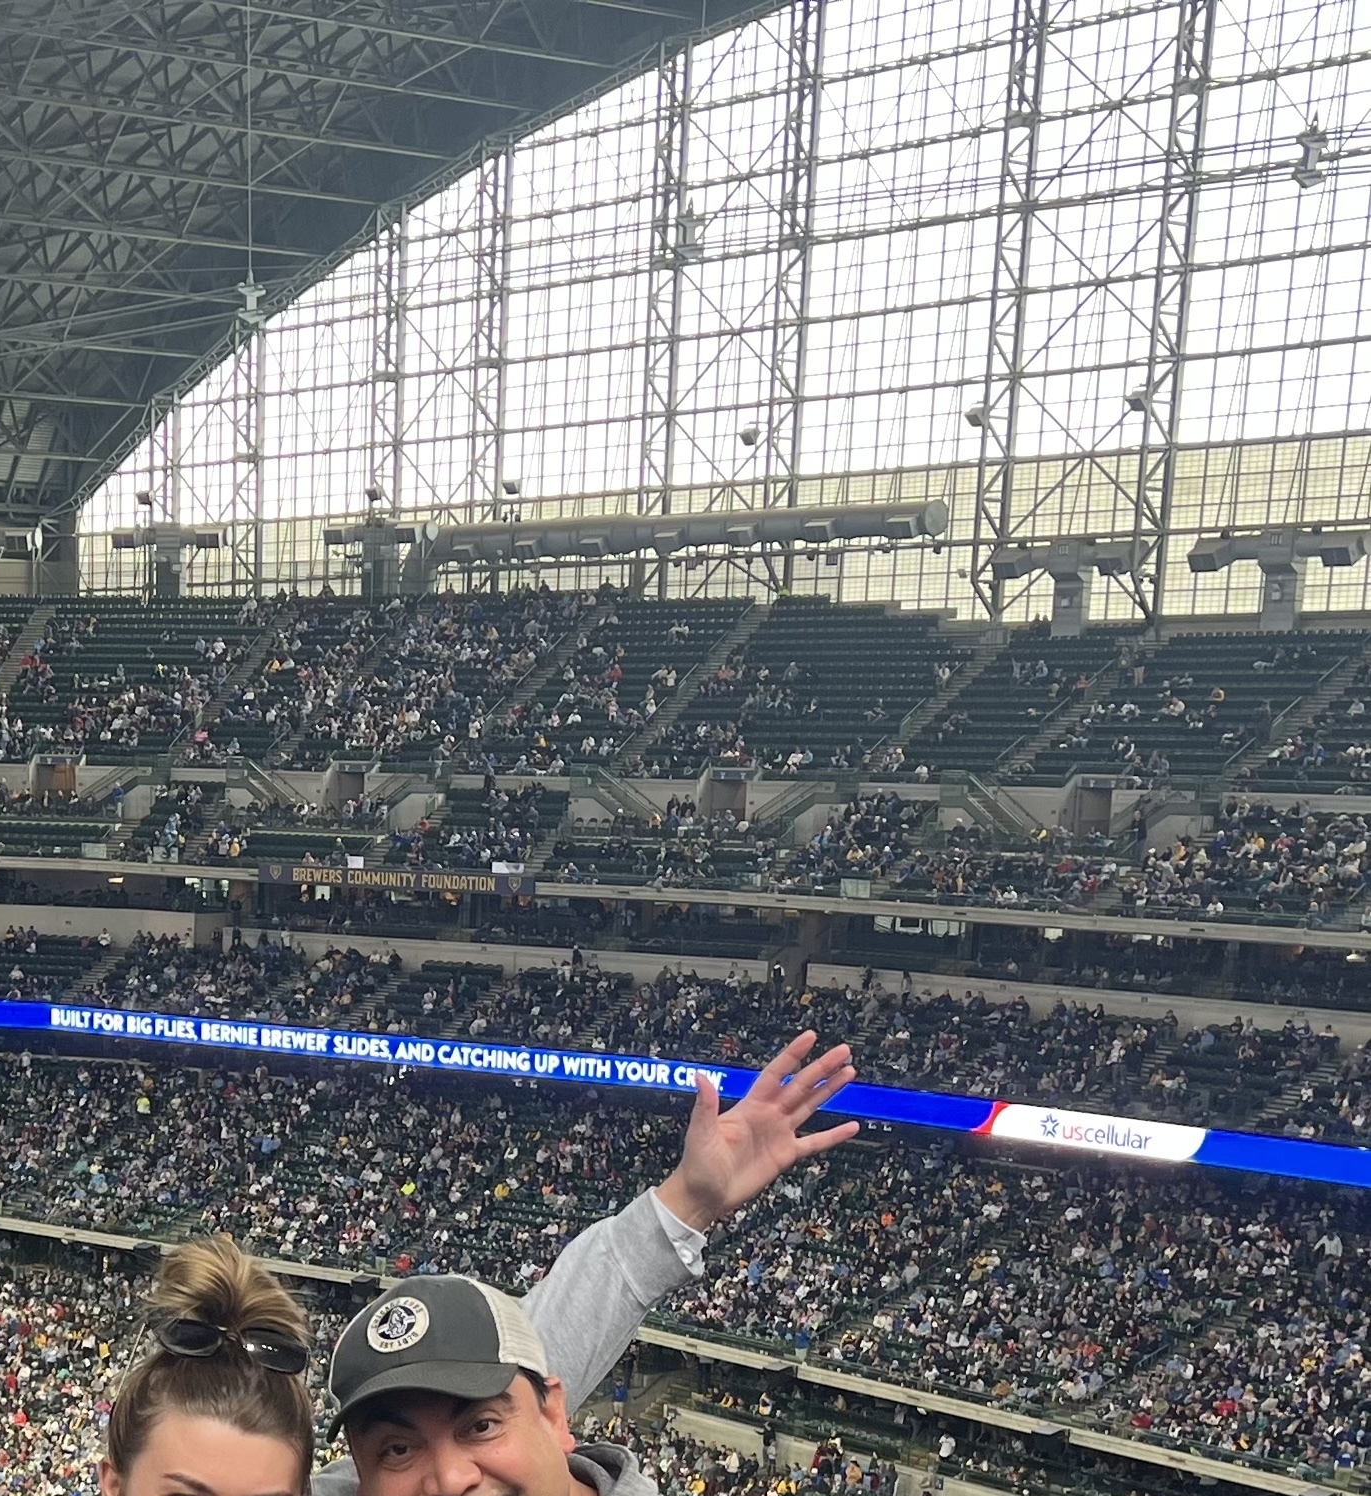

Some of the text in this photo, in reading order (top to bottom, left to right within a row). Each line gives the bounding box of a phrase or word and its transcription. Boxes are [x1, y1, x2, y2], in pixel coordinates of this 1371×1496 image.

[292, 867, 496, 891] BREWERS COMMUNITY FOUNDATION
[50, 1008, 91, 1029] BUILT
[93, 1012, 124, 1032] FOR
[127, 1015, 152, 1035] BIG
[154, 1018, 198, 1042] FLIES,
[200, 1023, 258, 1046] BERNIE
[333, 1036, 393, 1059] SLIDES,
[396, 1043, 435, 1063] AND
[438, 1044, 531, 1072] CATCHING
[534, 1054, 559, 1074] UP
[563, 1057, 611, 1079] WITH
[615, 1061, 677, 1085] YOUR
[1062, 1123, 1153, 1151] uscellular
